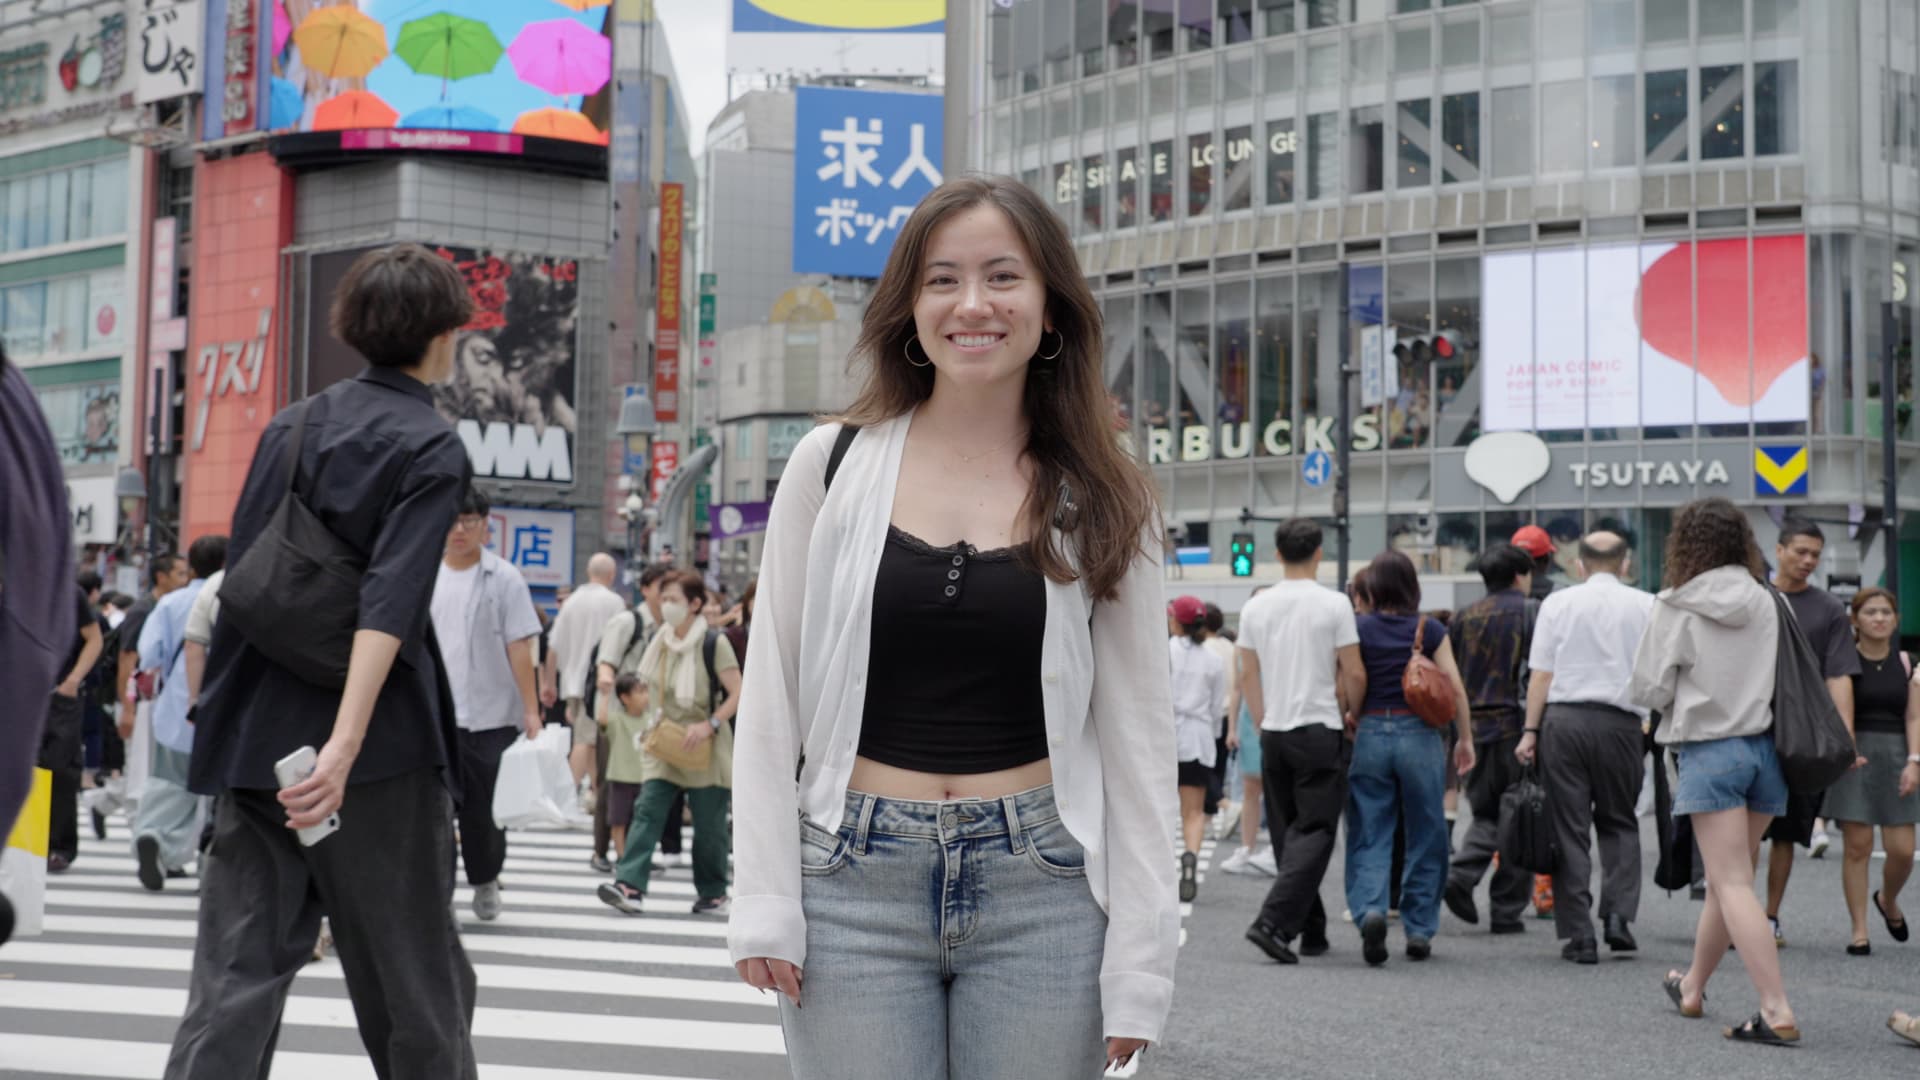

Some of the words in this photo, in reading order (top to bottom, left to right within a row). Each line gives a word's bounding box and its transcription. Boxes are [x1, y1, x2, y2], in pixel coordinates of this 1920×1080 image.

[141, 0, 195, 86] じゃ
[816, 116, 944, 190] 求人
[192, 305, 274, 452] クスリ
[1116, 414, 1381, 465] RBUCKS
[1568, 458, 1729, 488] TSUTAYA
